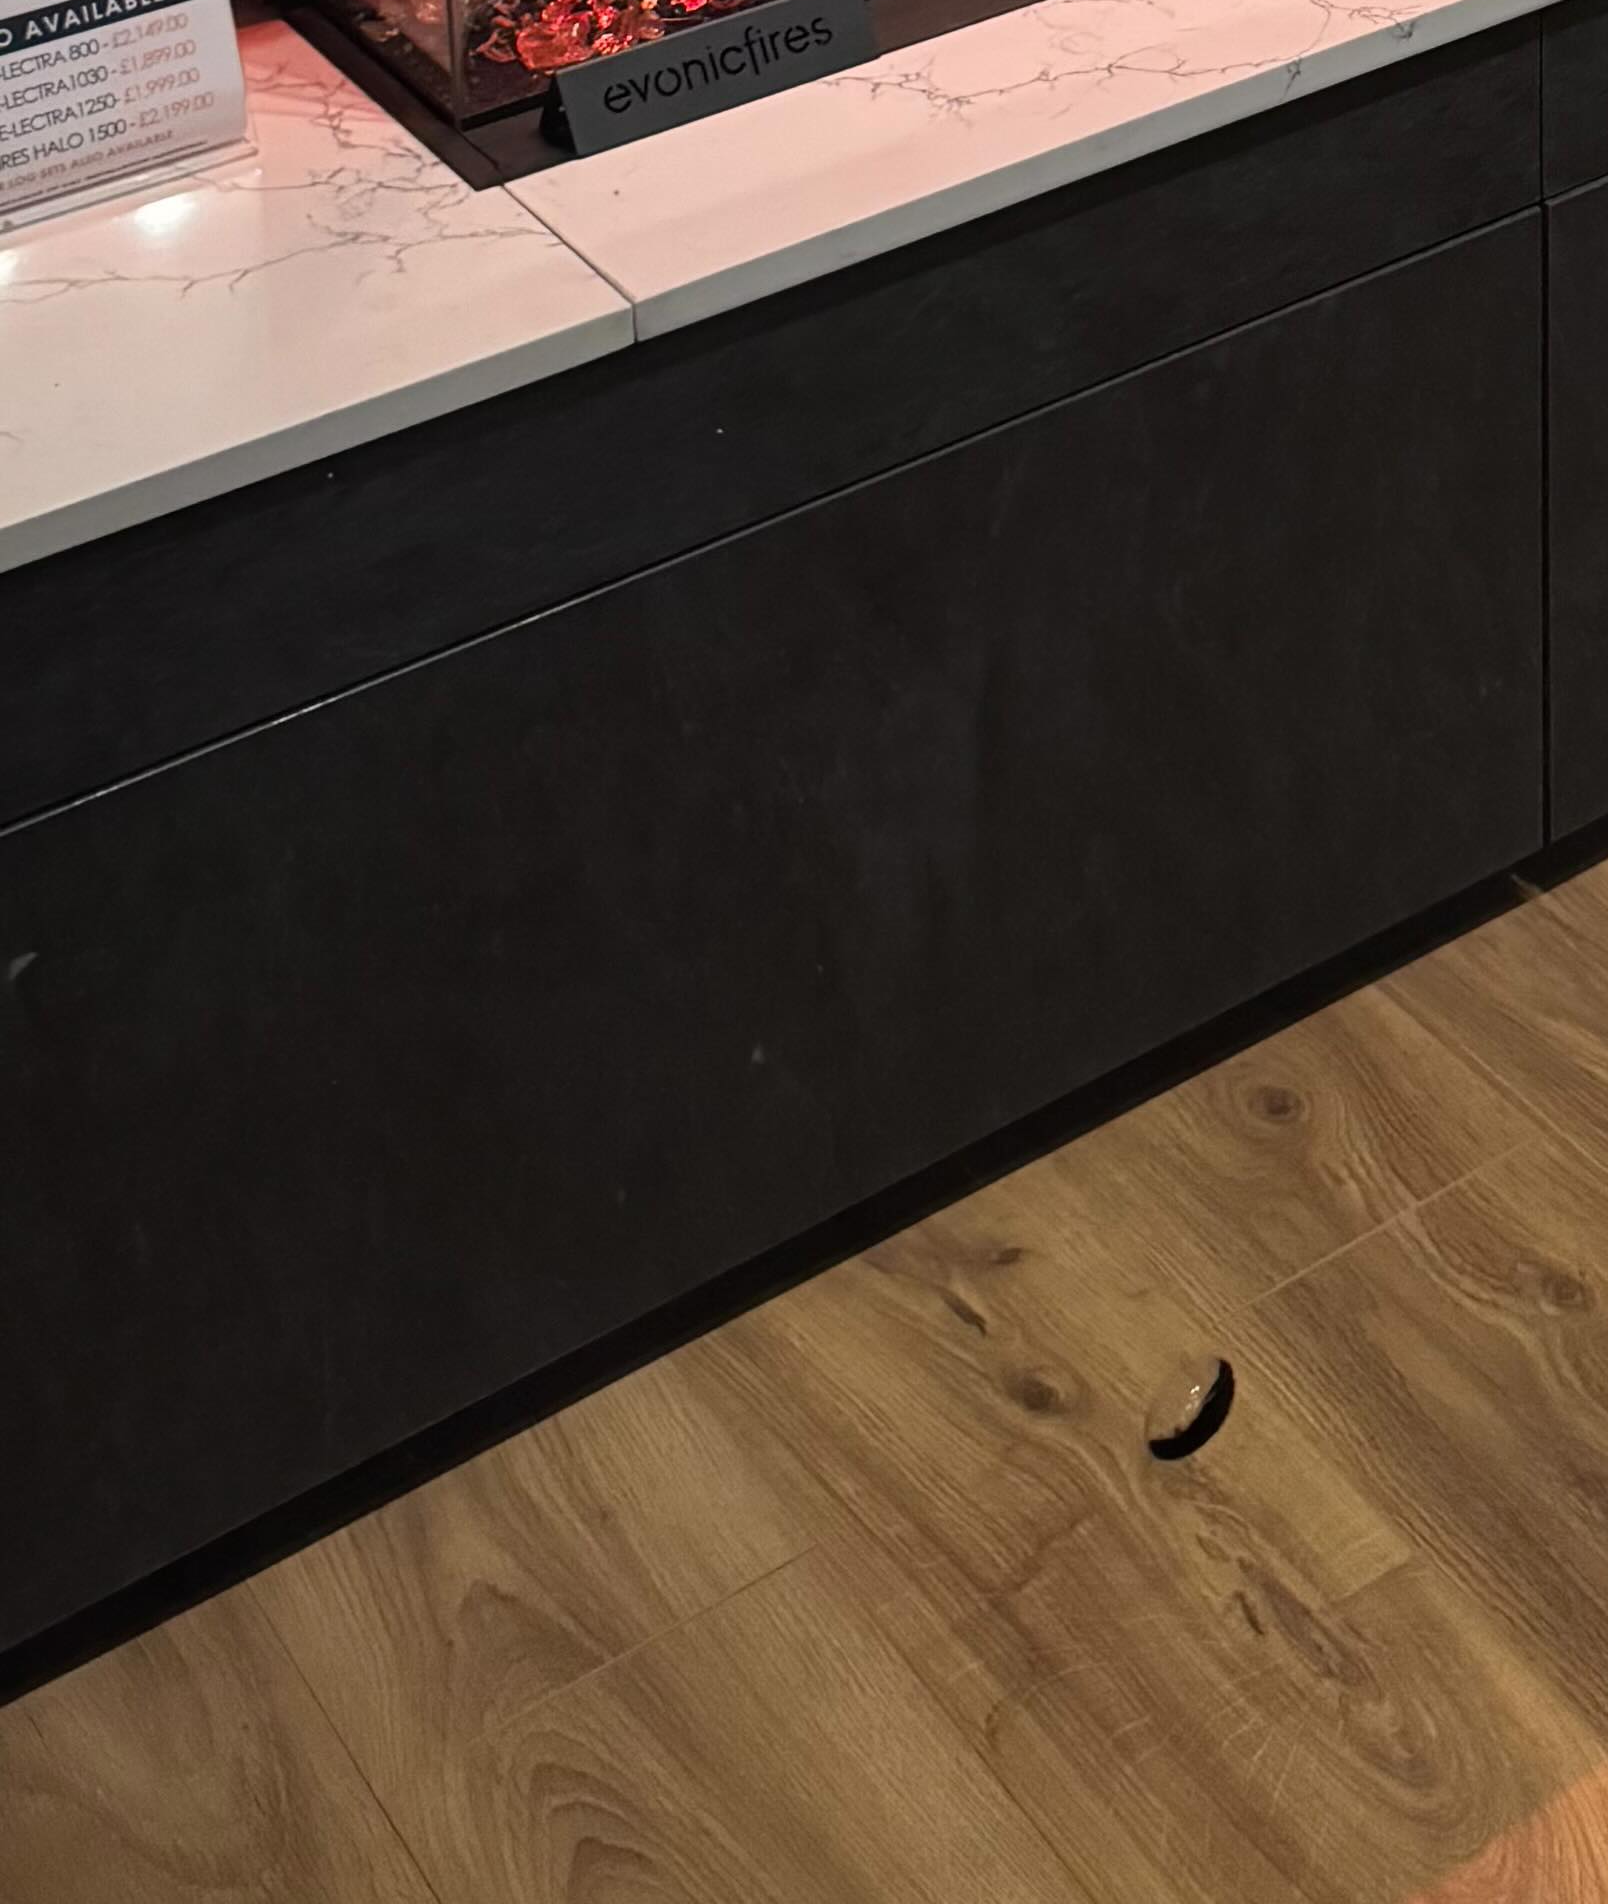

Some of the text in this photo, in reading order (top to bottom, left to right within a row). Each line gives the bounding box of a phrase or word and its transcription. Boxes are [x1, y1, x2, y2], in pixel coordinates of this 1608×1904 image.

[603, 16, 833, 114] evonicfires
[33, 132, 84, 161] HALO
[88, 118, 127, 143] 1500
